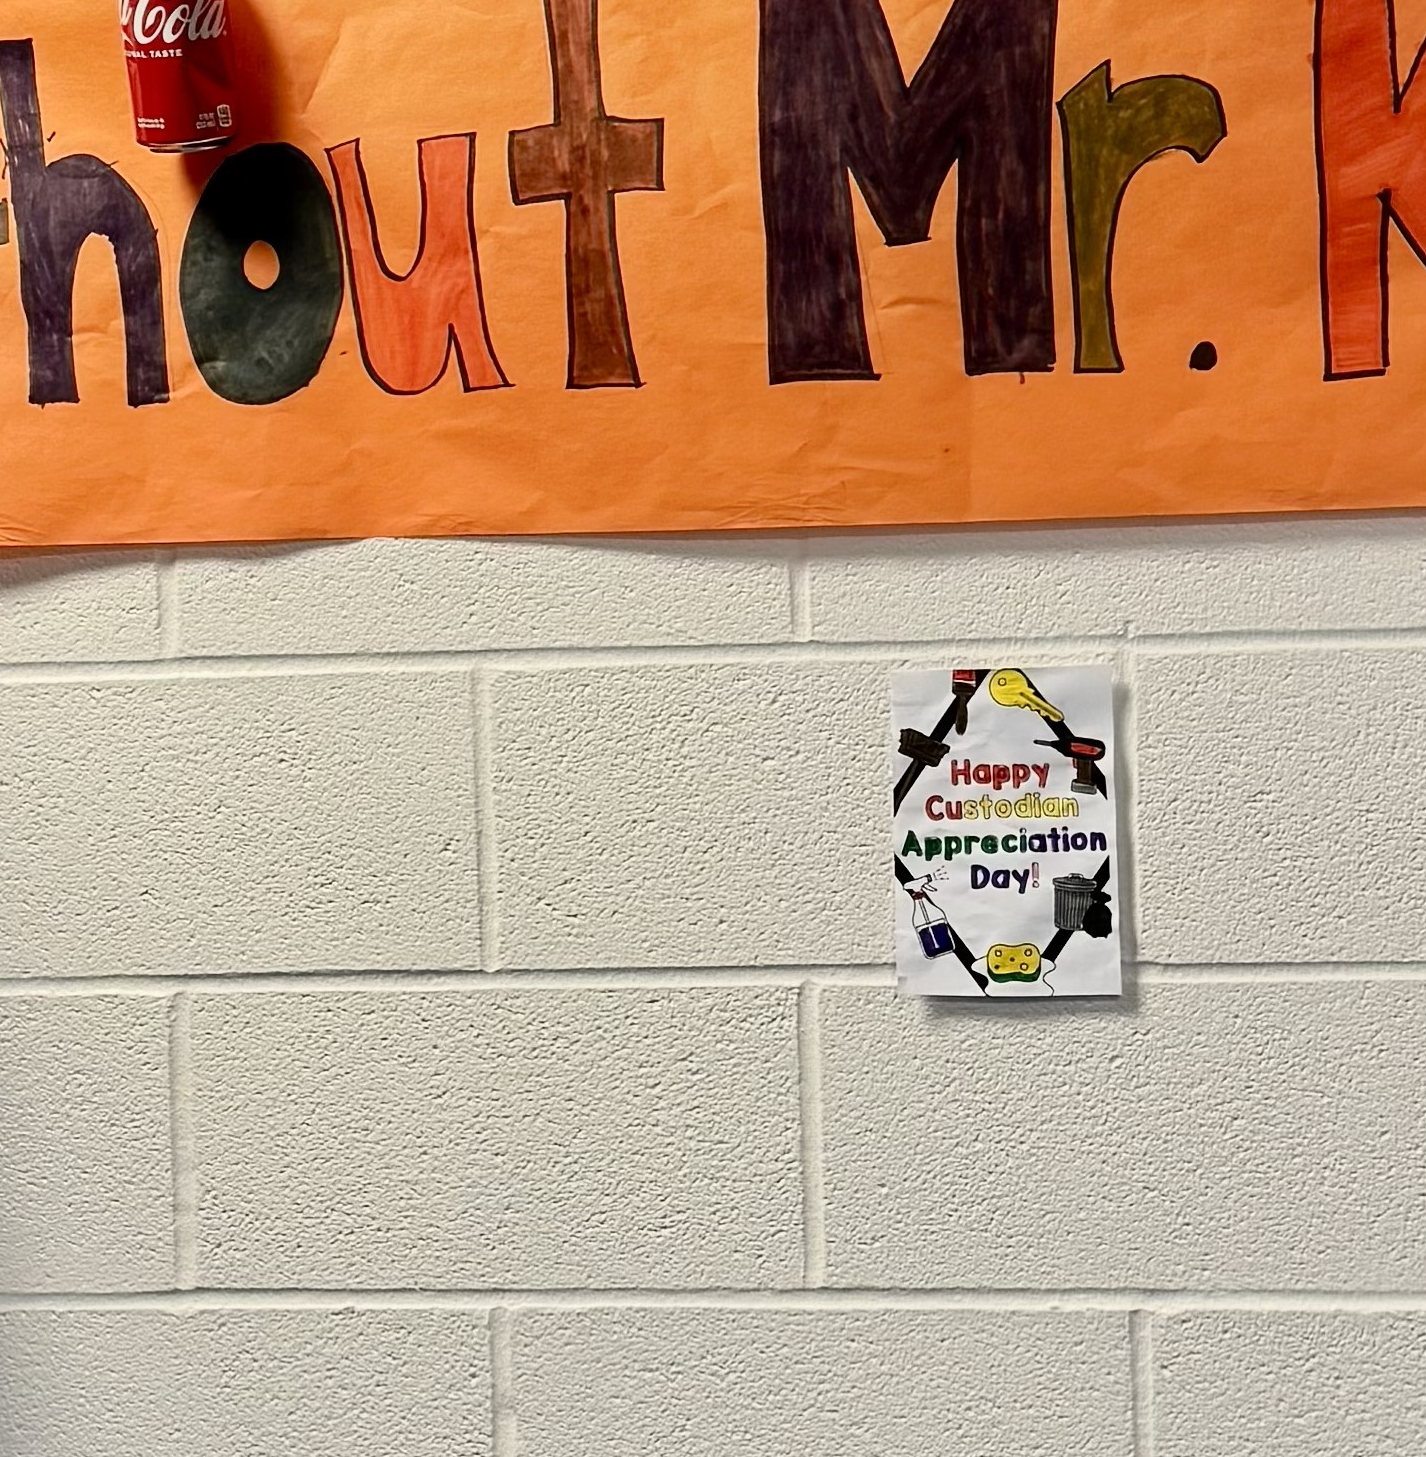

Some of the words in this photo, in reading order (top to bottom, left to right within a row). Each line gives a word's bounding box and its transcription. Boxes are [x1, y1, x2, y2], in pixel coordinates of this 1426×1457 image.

[149, 49, 183, 58] TASTE
[950, 759, 1050, 790] Happy
[924, 792, 1080, 822] Custodian
[901, 826, 1108, 862] Appreciation
[971, 863, 1041, 894] Day!
